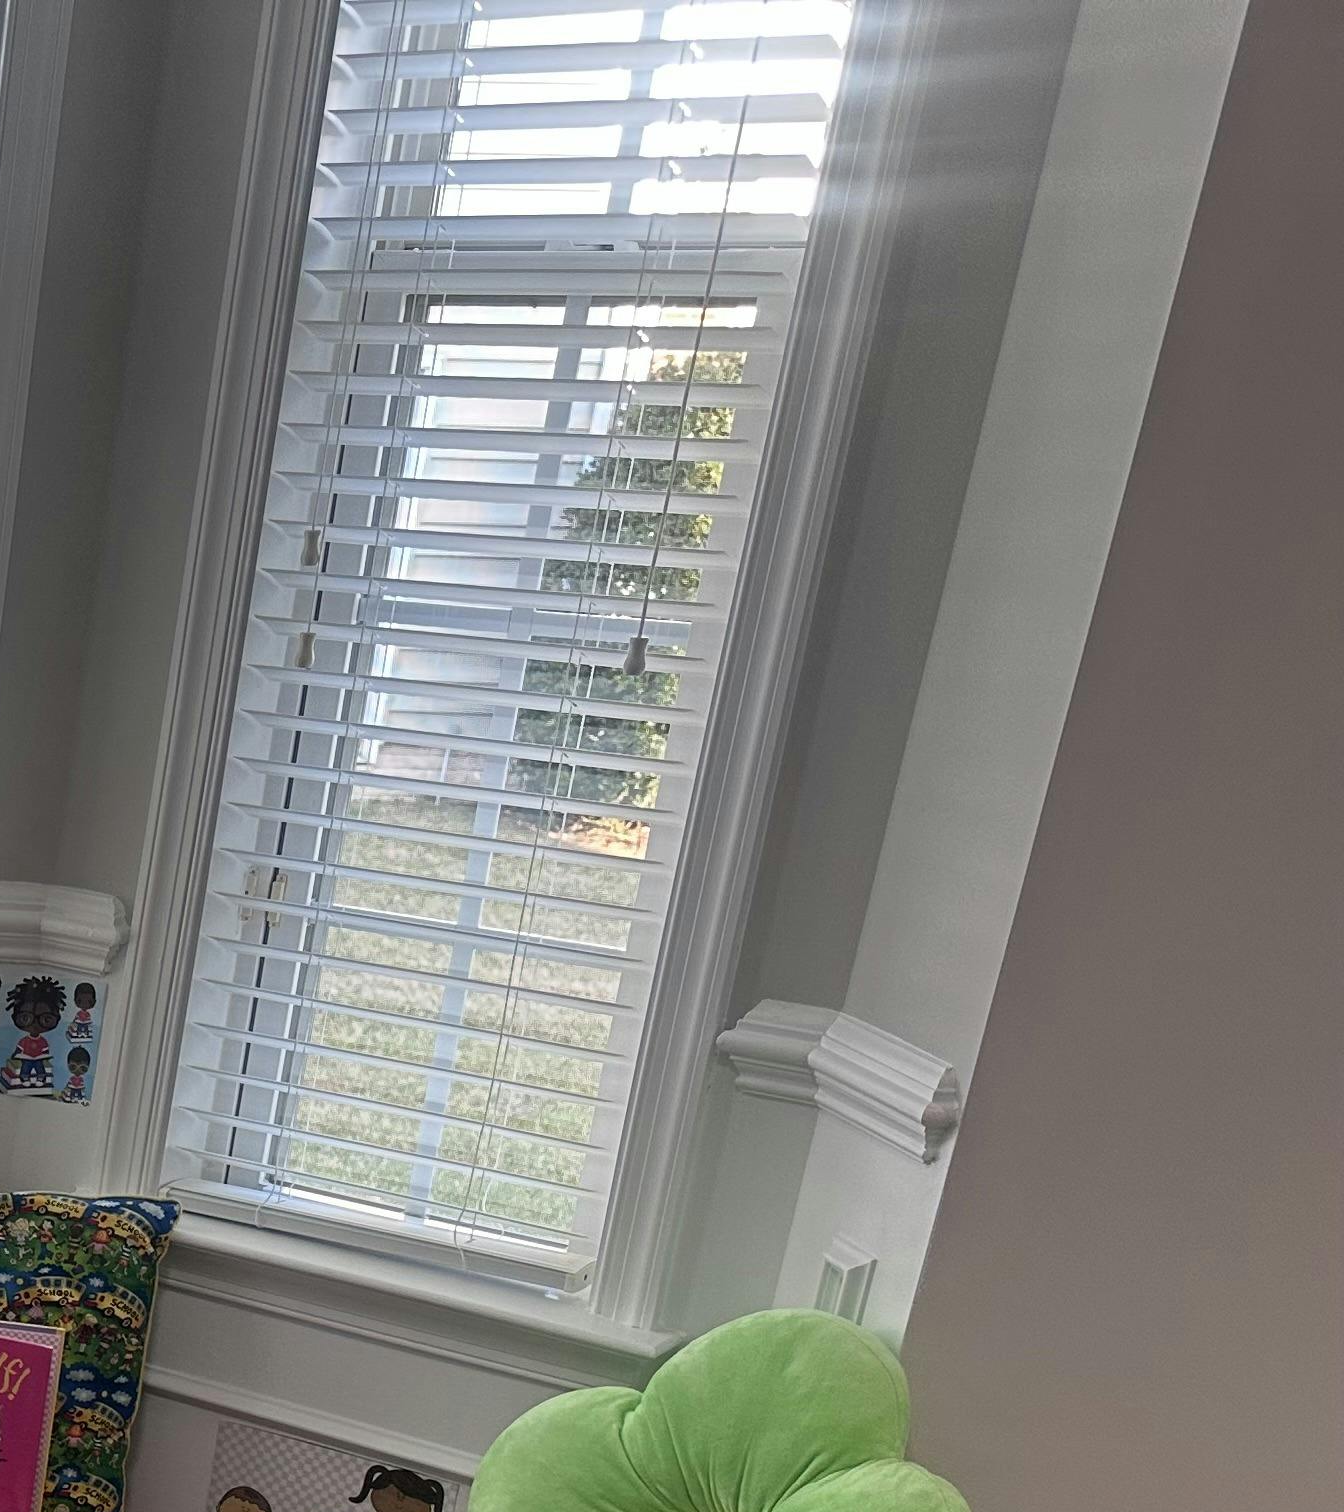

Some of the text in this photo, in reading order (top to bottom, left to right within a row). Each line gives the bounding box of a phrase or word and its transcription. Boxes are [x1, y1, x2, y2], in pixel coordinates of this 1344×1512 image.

[45, 1200, 79, 1214] SCHOOL
[114, 1219, 147, 1243] SCHOOL
[37, 1289, 74, 1298] SCHOOL
